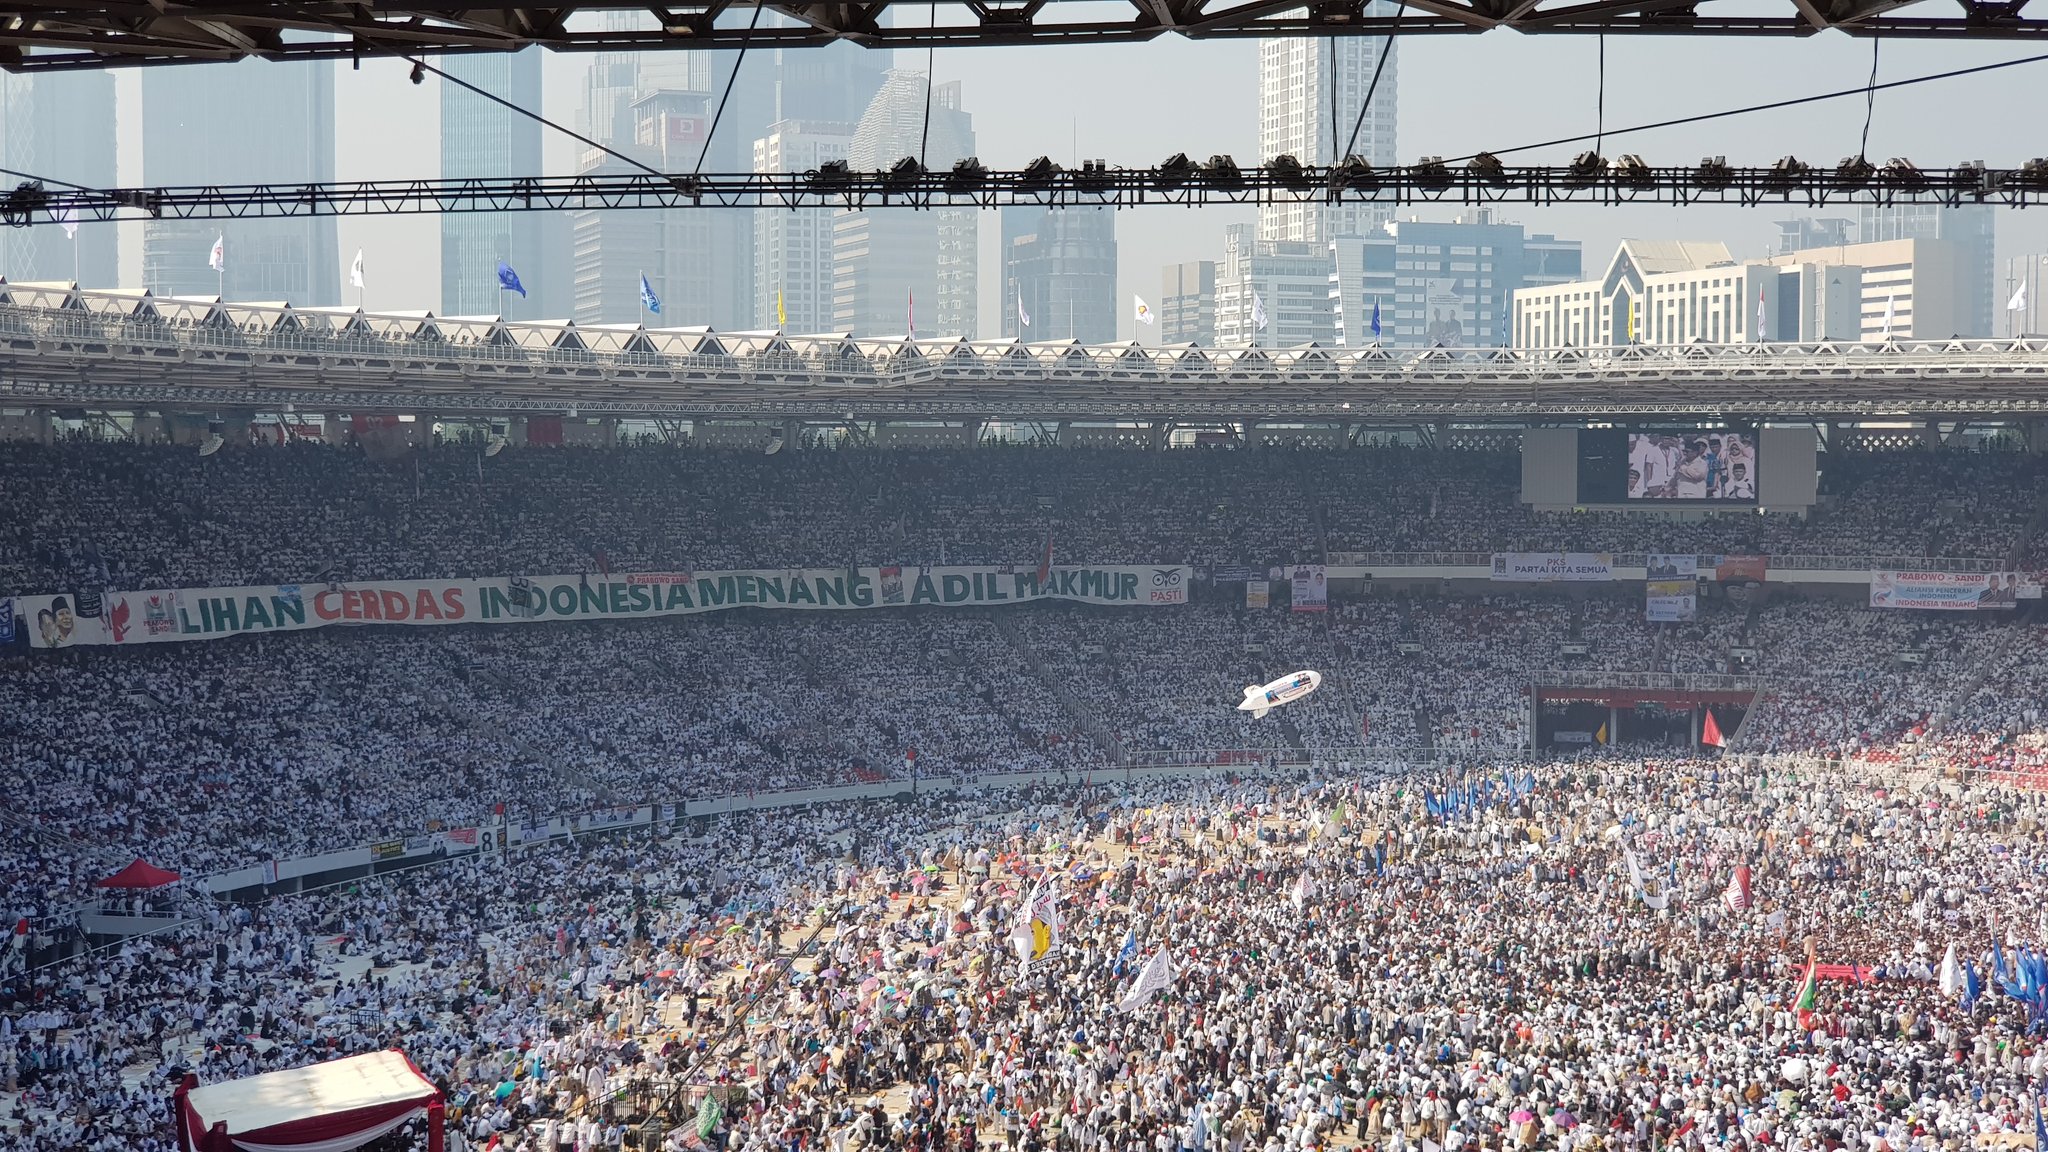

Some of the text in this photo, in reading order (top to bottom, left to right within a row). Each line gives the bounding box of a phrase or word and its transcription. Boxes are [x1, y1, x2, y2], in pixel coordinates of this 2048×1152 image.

[1547, 558, 1566, 566] PKS
[1575, 566, 1608, 574] SEMUA
[1896, 573, 1945, 581] PRABOWO
[1954, 574, 1985, 582] SANDI
[313, 588, 465, 621] CERDAS
[697, 575, 874, 606] MENANG
[909, 572, 1006, 604] ADIL
[1013, 569, 1138, 601] MAKMUR
[1150, 590, 1182, 601] PASTI
[1940, 600, 1977, 608] MENANG
[482, 832, 493, 852] 8
